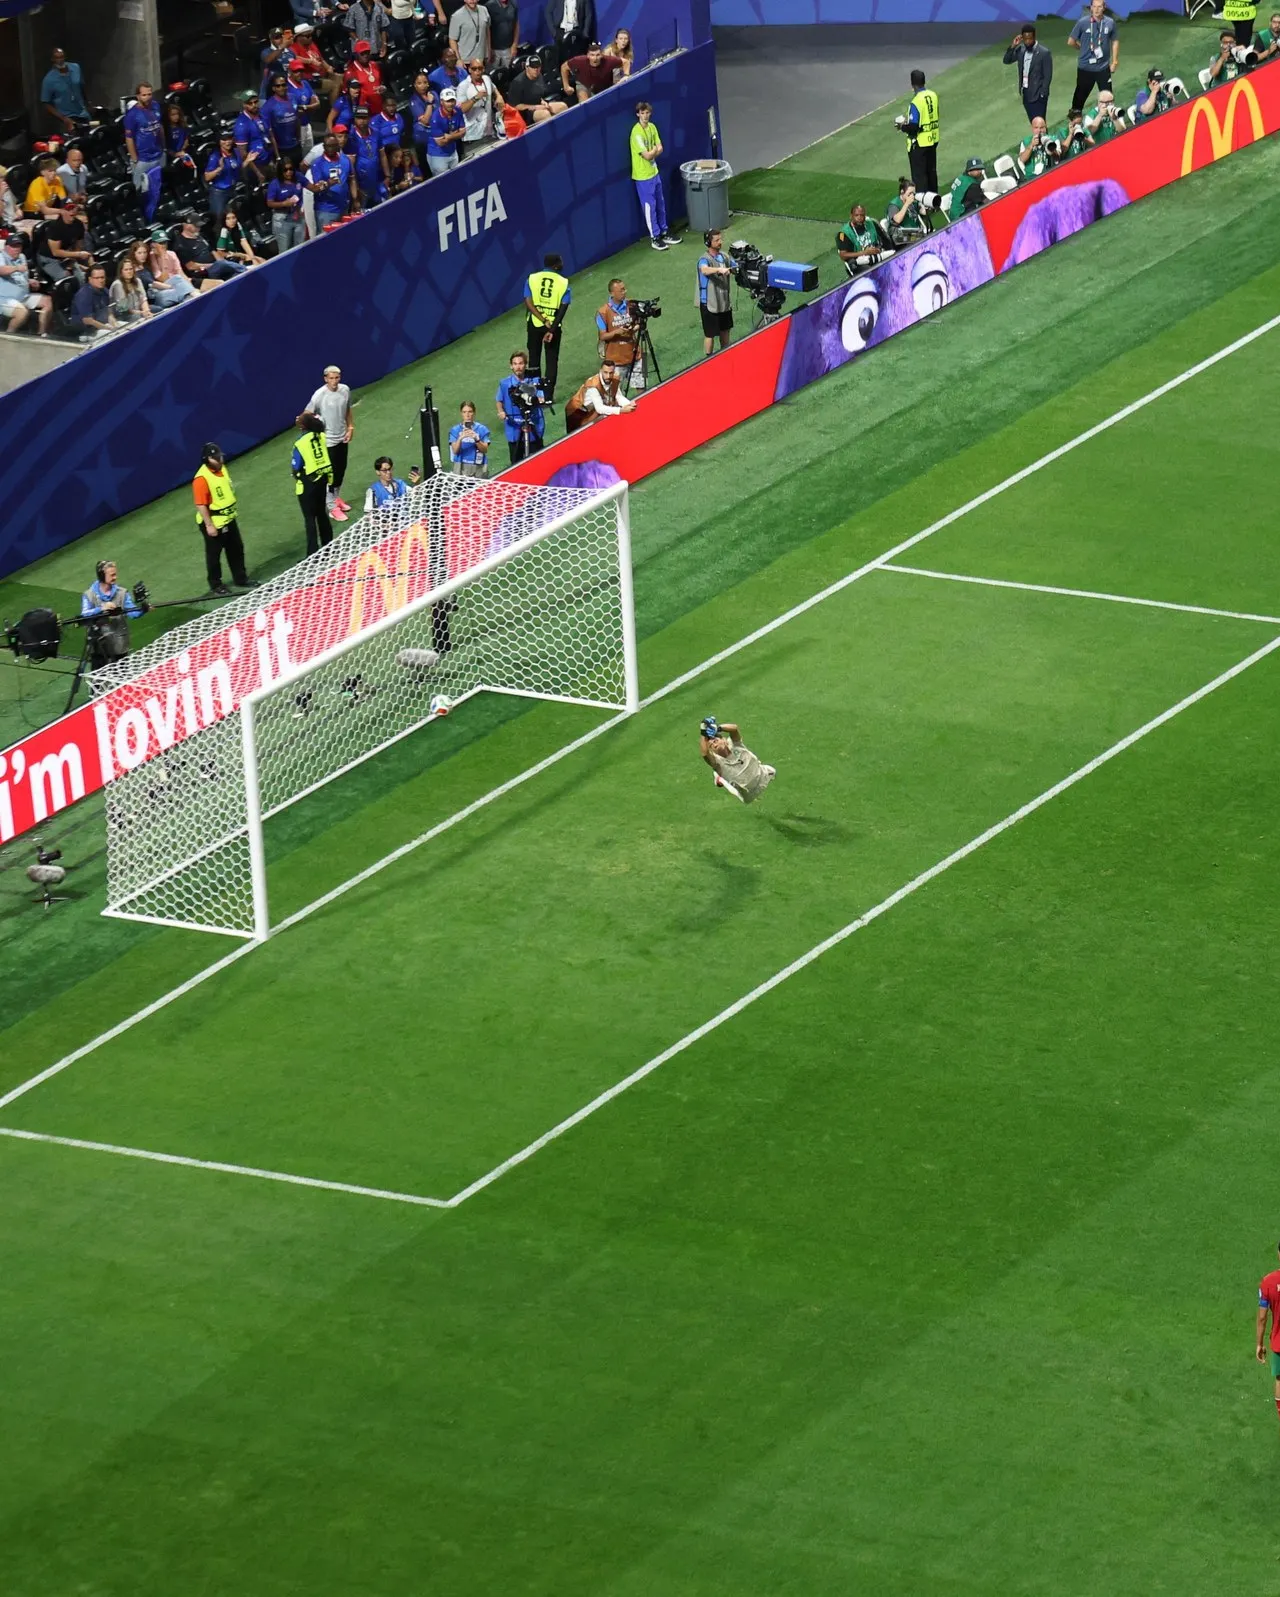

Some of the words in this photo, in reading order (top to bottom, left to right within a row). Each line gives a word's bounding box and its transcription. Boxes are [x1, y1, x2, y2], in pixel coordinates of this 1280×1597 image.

[437, 181, 508, 253] FIFA
[0, 742, 86, 842] i'm
[93, 627, 242, 784] lovin'
[254, 609, 294, 690] it
